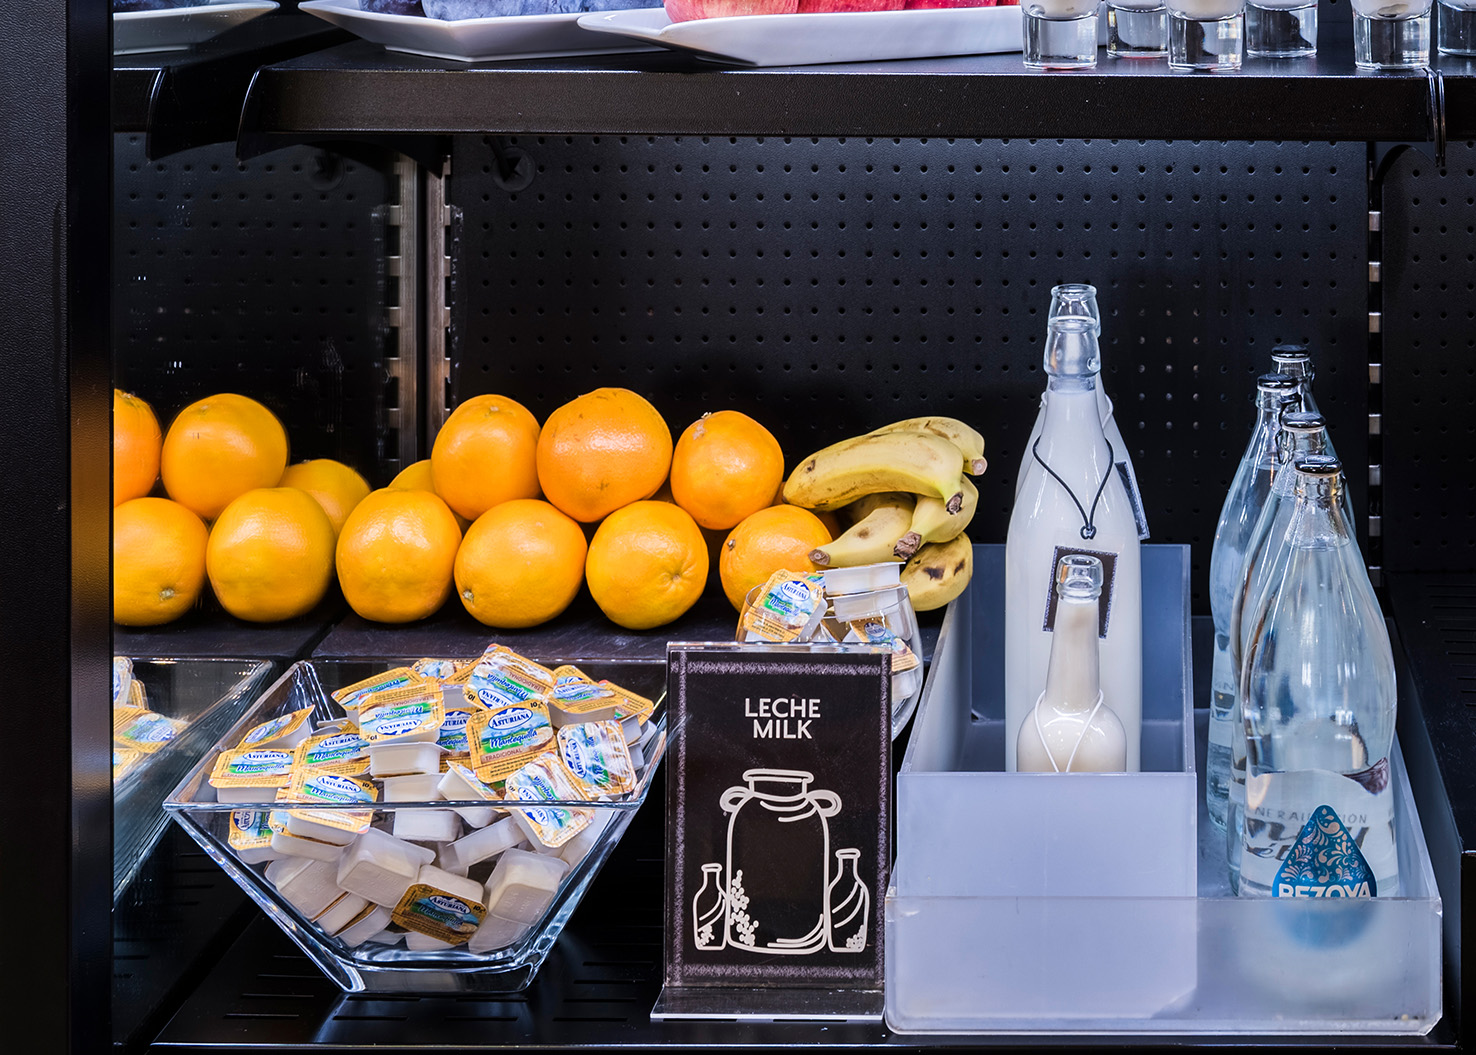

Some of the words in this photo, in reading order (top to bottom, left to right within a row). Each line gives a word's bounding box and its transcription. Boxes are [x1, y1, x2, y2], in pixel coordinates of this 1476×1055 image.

[744, 697, 822, 719] LECHE
[492, 712, 530, 728] ASTURIANA
[752, 719, 813, 740] MILK
[490, 728, 538, 749] Mantequilla
[485, 748, 523, 761] TRADICIONAL
[432, 896, 467, 914] ASTURIANA
